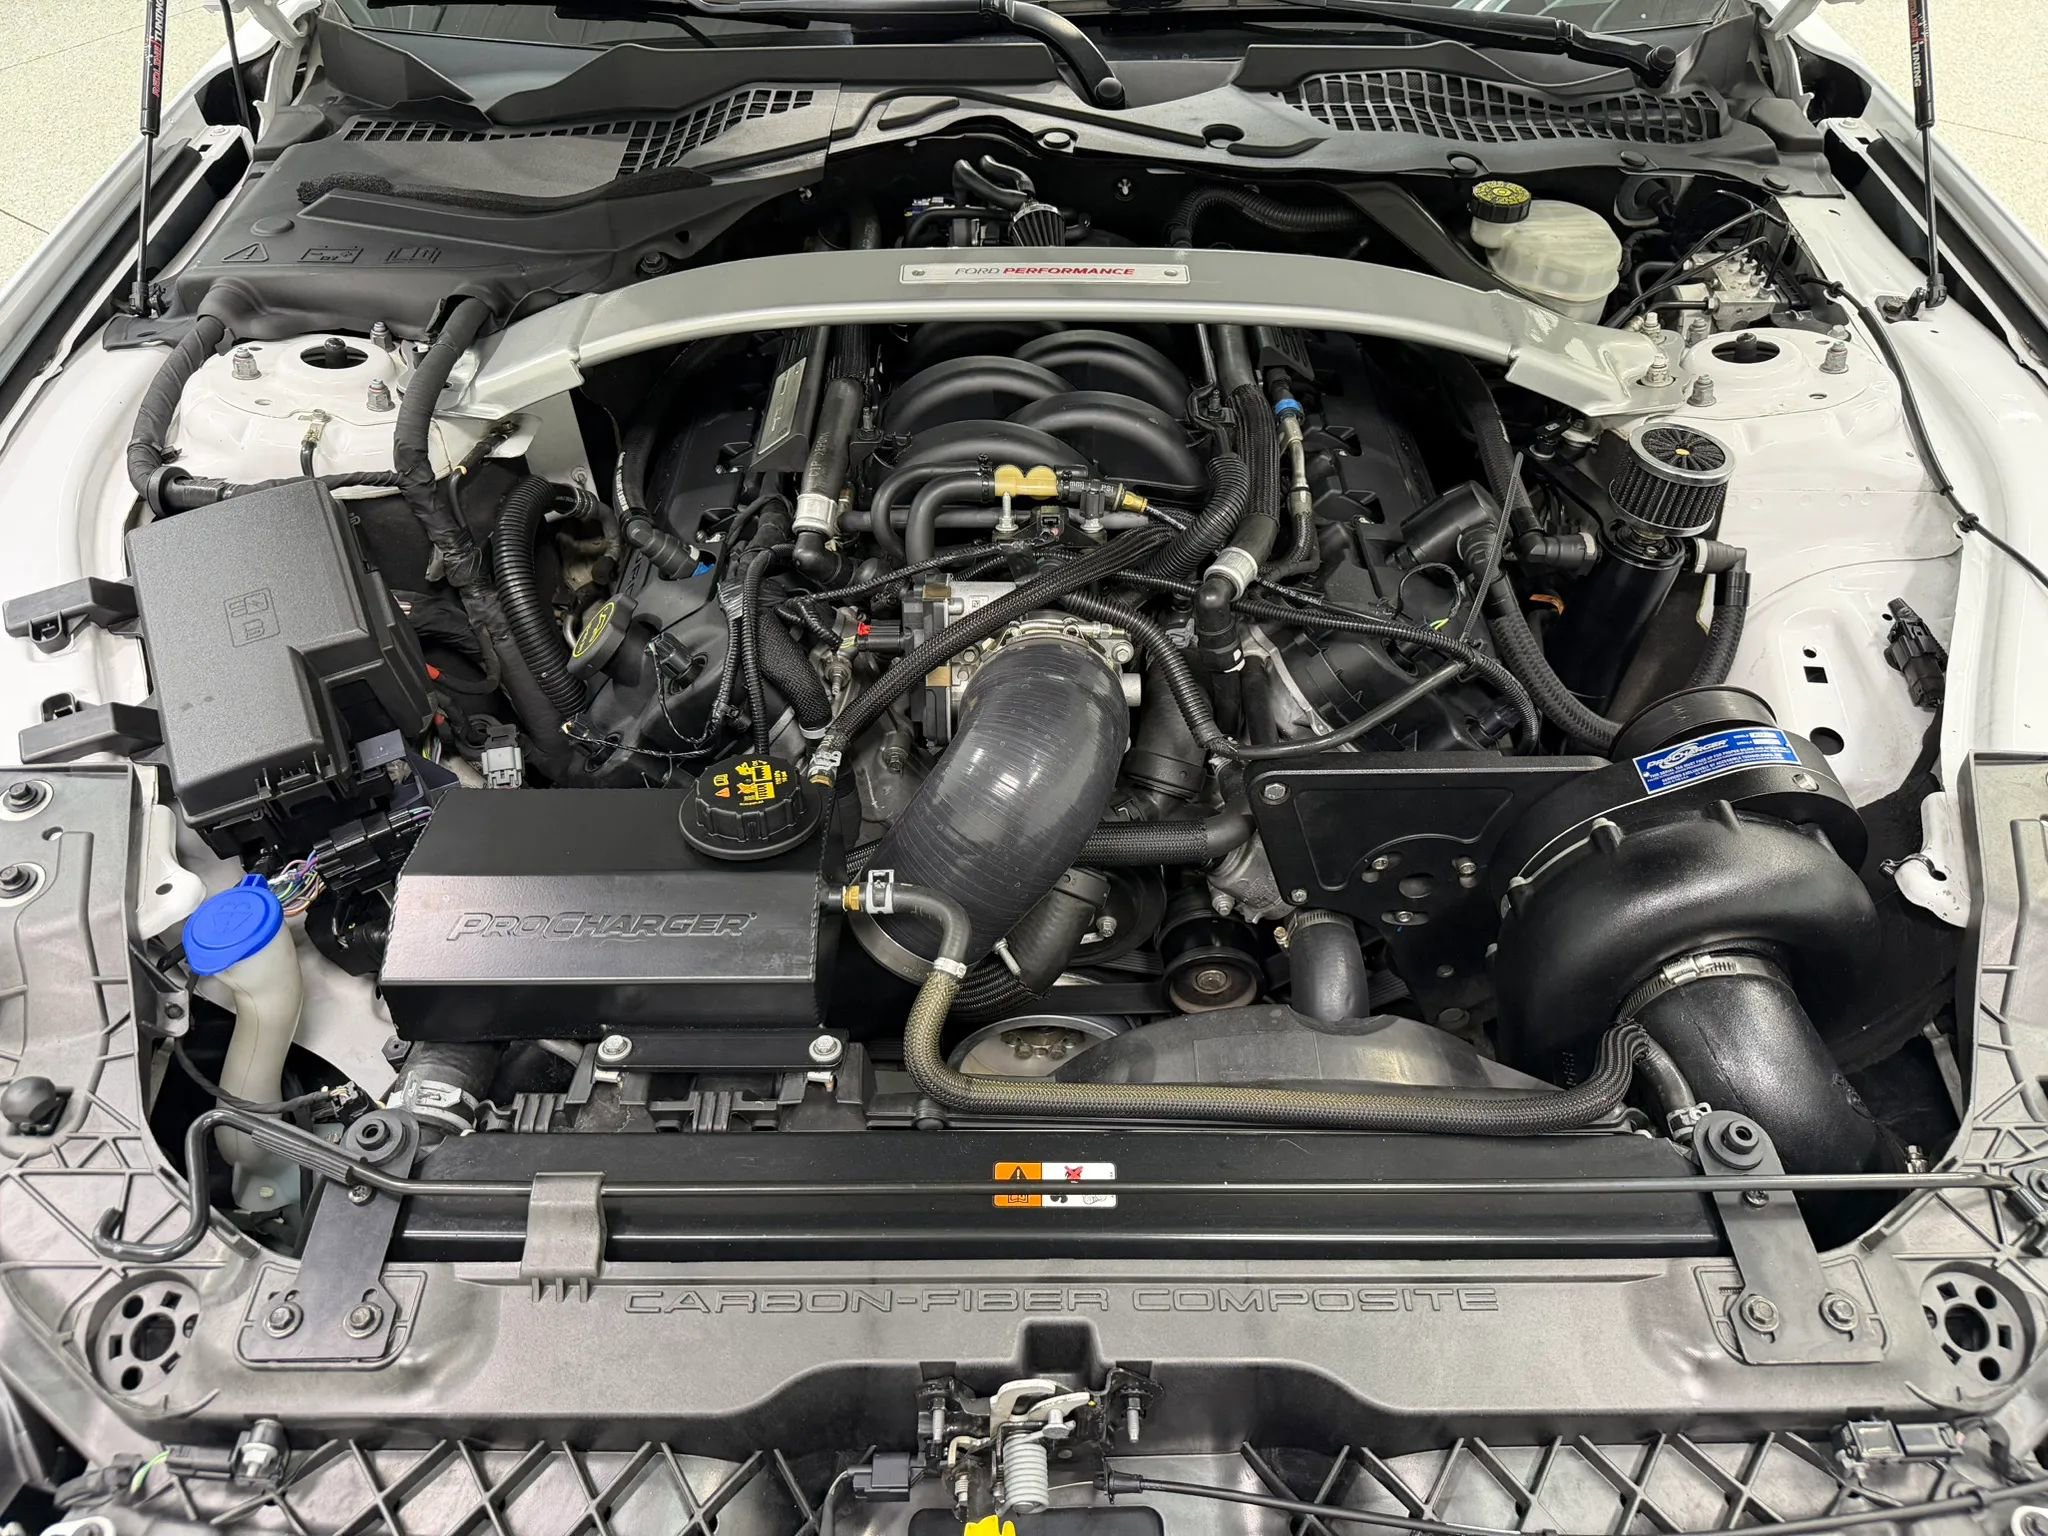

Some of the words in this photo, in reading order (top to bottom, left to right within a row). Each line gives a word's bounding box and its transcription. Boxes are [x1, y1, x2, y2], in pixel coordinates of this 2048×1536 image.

[1912, 43, 1921, 87] TUNING
[955, 267, 1000, 275] FORD
[1003, 267, 1136, 276] PERFORMANCE
[446, 911, 752, 941] PROCHARGER
[624, 1288, 1109, 1314] CARBON-FIBER
[1132, 1287, 1499, 1313] COMPOSITE
